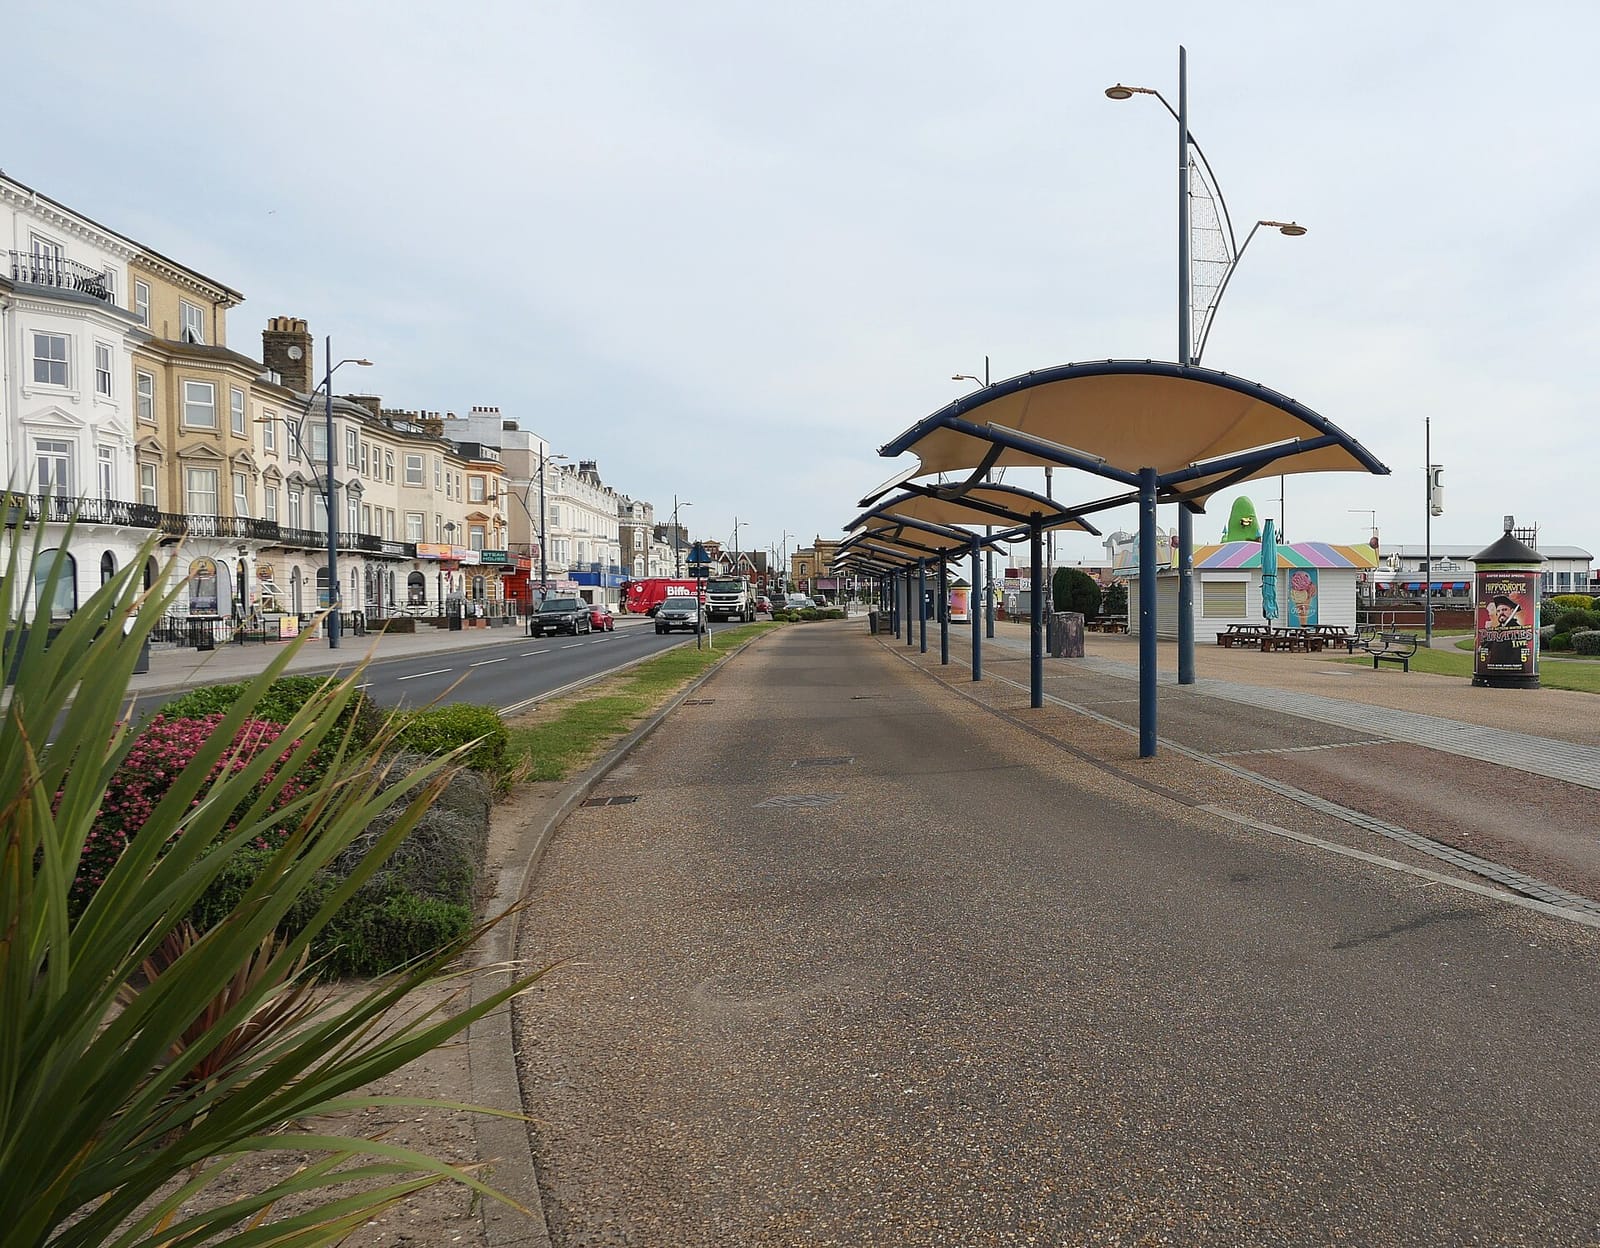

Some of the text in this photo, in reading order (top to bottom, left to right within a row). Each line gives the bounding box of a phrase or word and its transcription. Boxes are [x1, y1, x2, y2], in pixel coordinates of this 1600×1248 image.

[1485, 582, 1526, 591] HIPPODROME
[1479, 629, 1532, 642] PIRATES
[1512, 640, 1528, 648] LIVE
